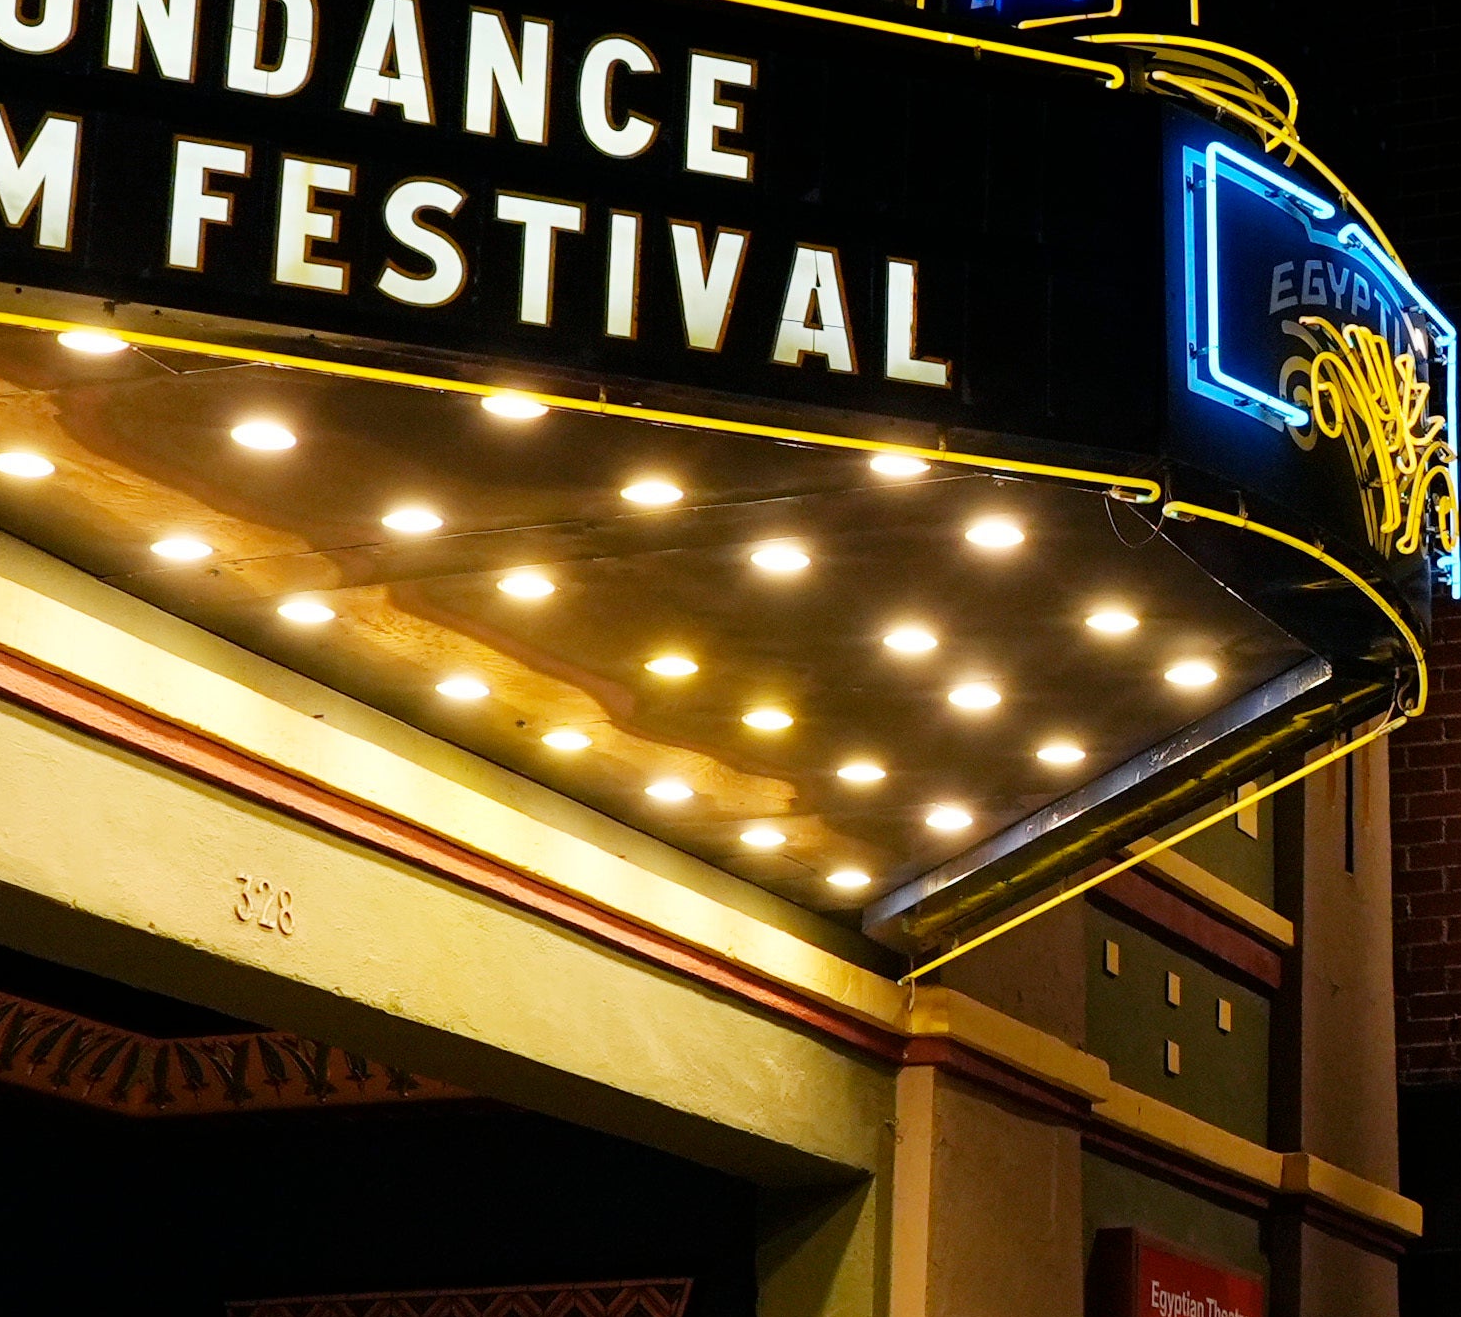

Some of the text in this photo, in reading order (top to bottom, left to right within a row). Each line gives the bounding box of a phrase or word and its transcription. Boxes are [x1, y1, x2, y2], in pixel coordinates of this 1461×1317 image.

[162, 134, 955, 389] FESTIVAL
[1269, 258, 1415, 368] EGYPTI
[234, 873, 294, 936] 328
